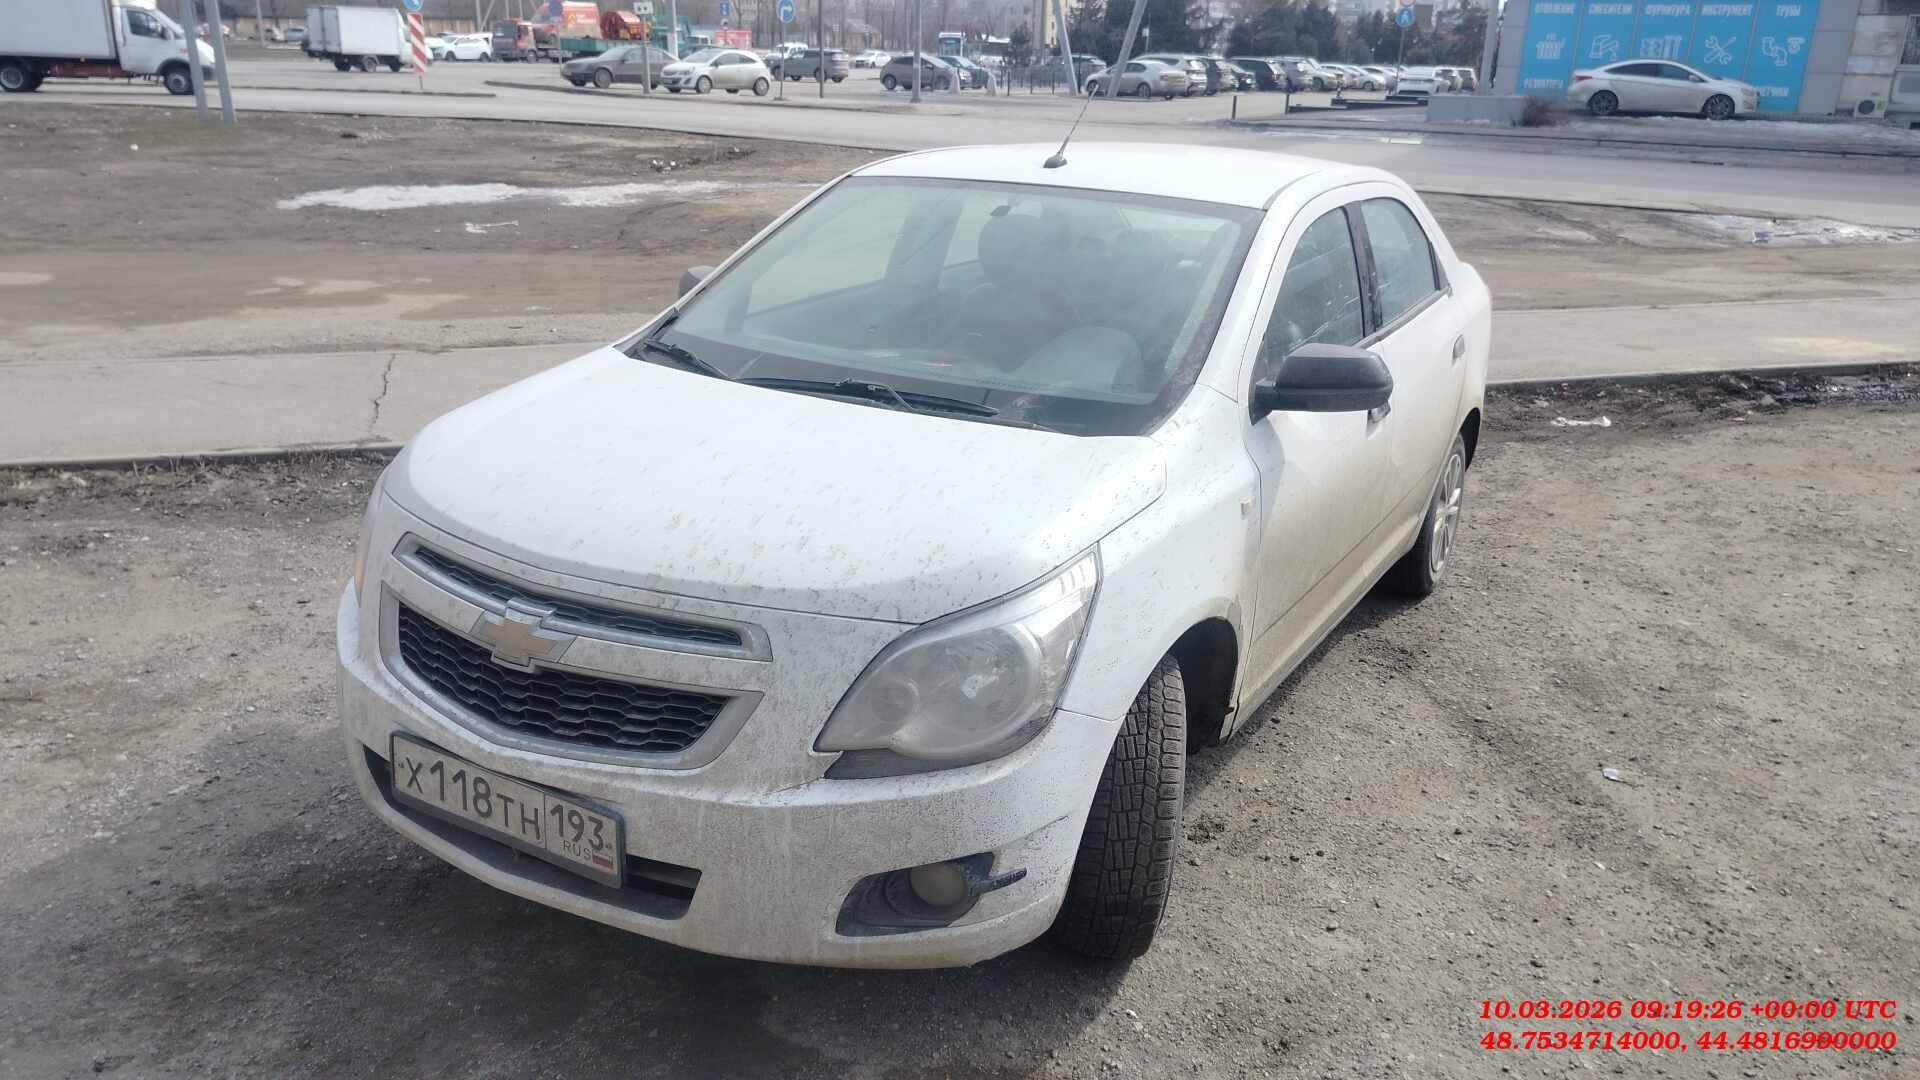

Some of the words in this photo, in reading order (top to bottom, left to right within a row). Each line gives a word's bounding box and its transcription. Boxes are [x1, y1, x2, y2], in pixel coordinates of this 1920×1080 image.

[1645, 4, 1691, 16] ФУРНИТУРА
[1701, 4, 1753, 16] ИНСТРУМЕНТ
[1776, 4, 1801, 17] ТРУБЫ
[550, 804, 605, 851] 193
[563, 839, 592, 861] RUS
